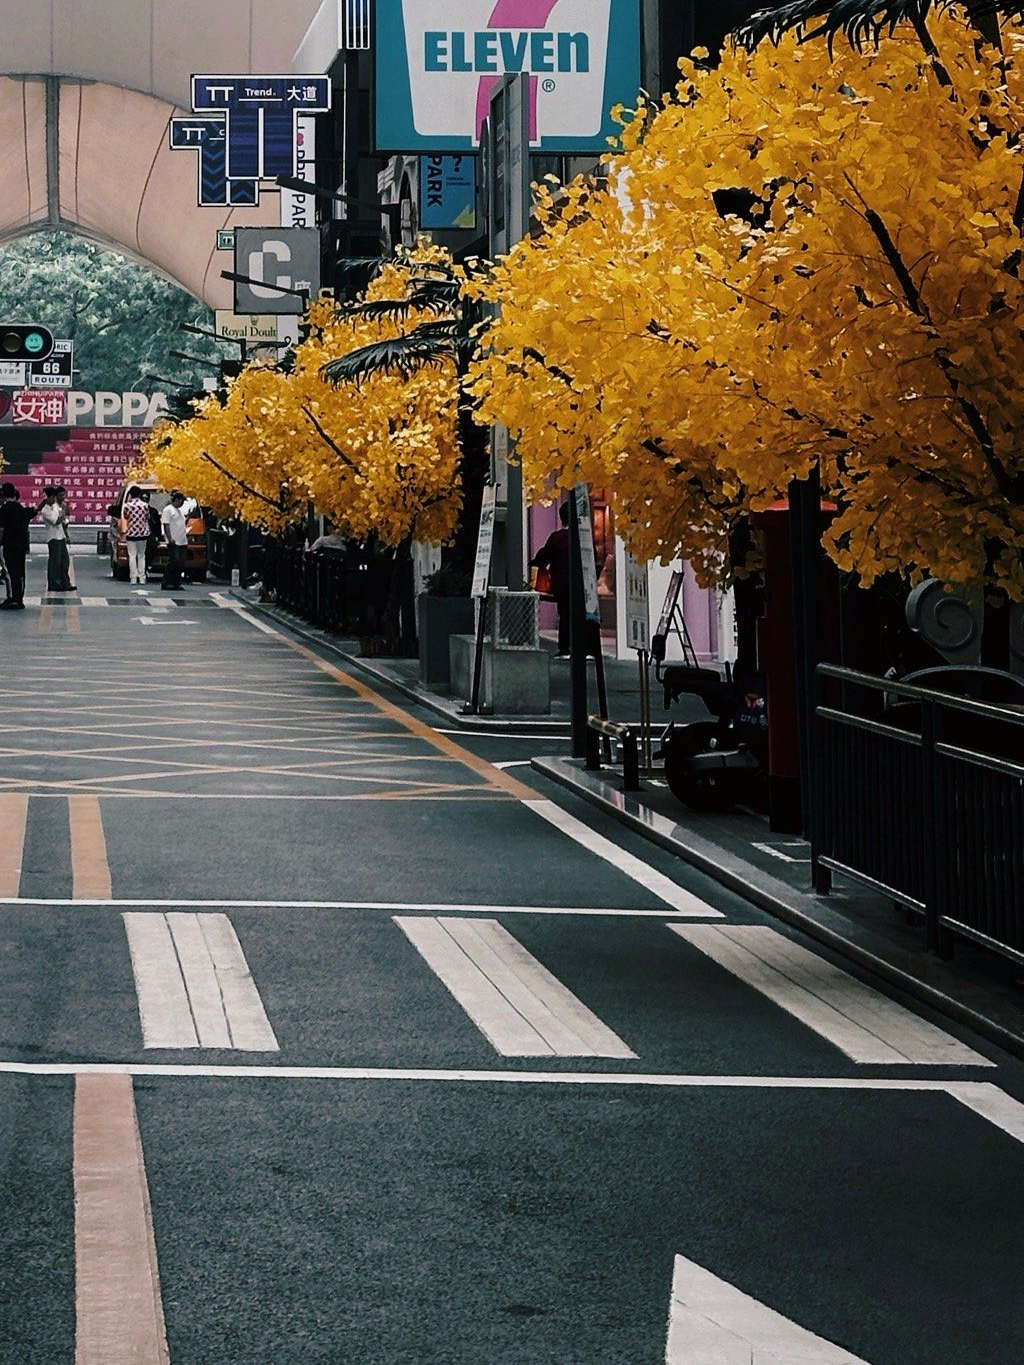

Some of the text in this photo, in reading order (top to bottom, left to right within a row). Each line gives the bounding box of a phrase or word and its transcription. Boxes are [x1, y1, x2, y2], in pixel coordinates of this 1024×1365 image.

[205, 86, 234, 102] TT
[287, 86, 317, 102] 大道
[182, 127, 206, 141] TT
[248, 240, 292, 299] C
[221, 326, 248, 338] Royal
[13, 397, 64, 424] 女神
